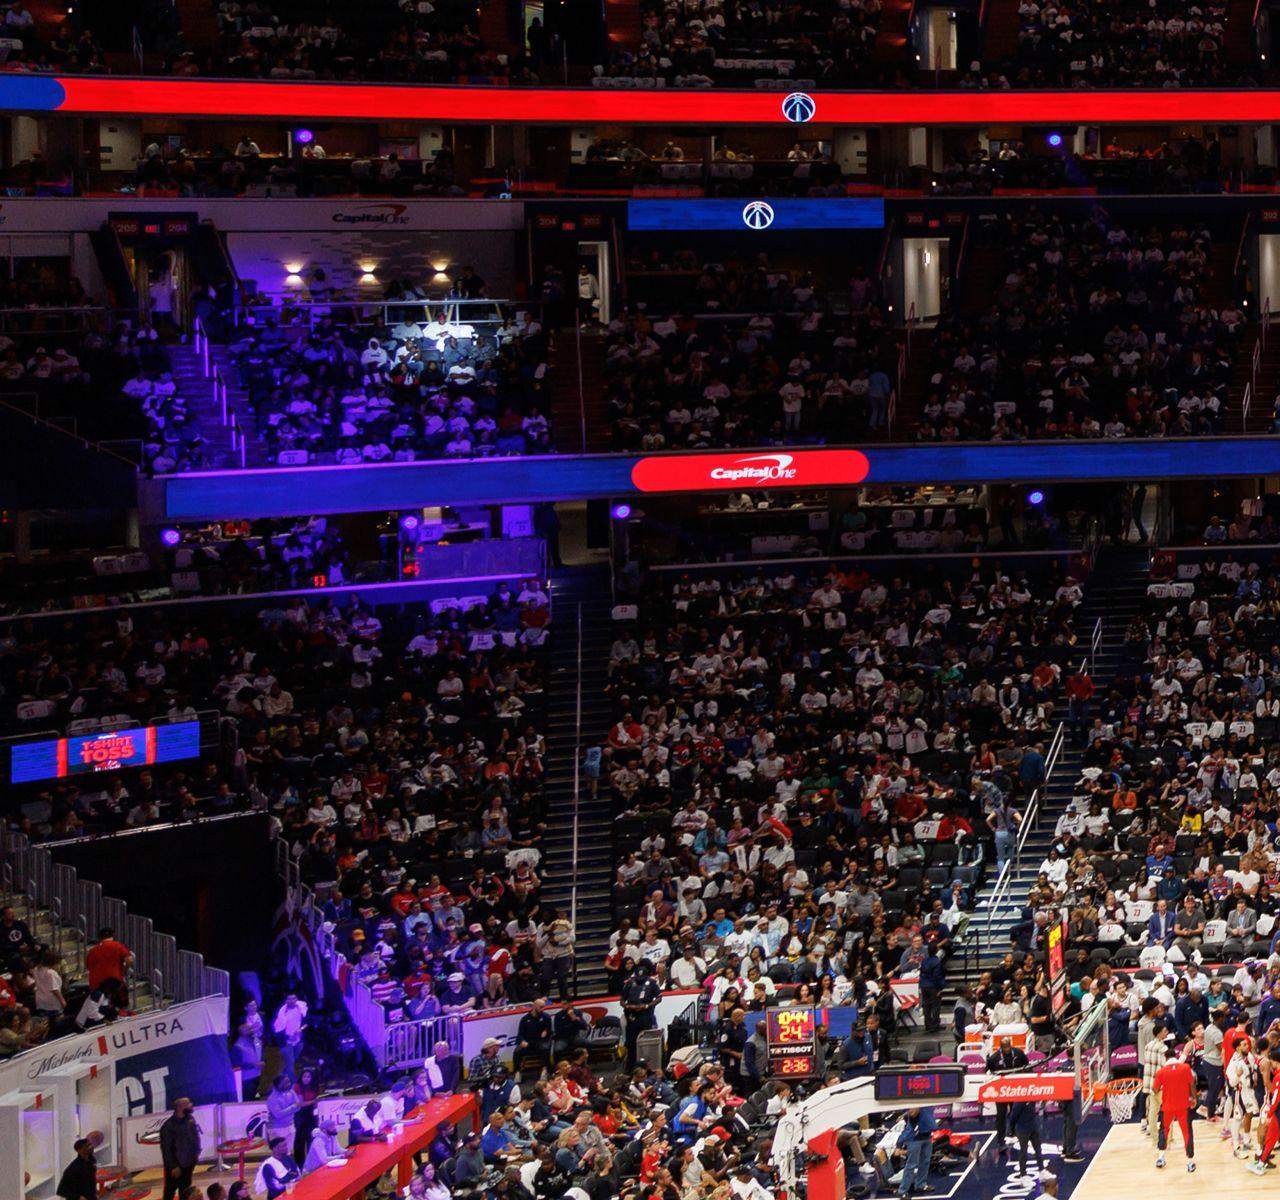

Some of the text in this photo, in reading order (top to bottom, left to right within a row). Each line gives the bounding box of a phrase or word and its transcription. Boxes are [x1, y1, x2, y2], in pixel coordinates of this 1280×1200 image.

[82, 736, 133, 751] T-SHIRT
[80, 745, 135, 765] TOSS
[112, 1018, 184, 1050] ULTRA
[780, 1026, 803, 1042] 24
[782, 1059, 809, 1073] 2:36
